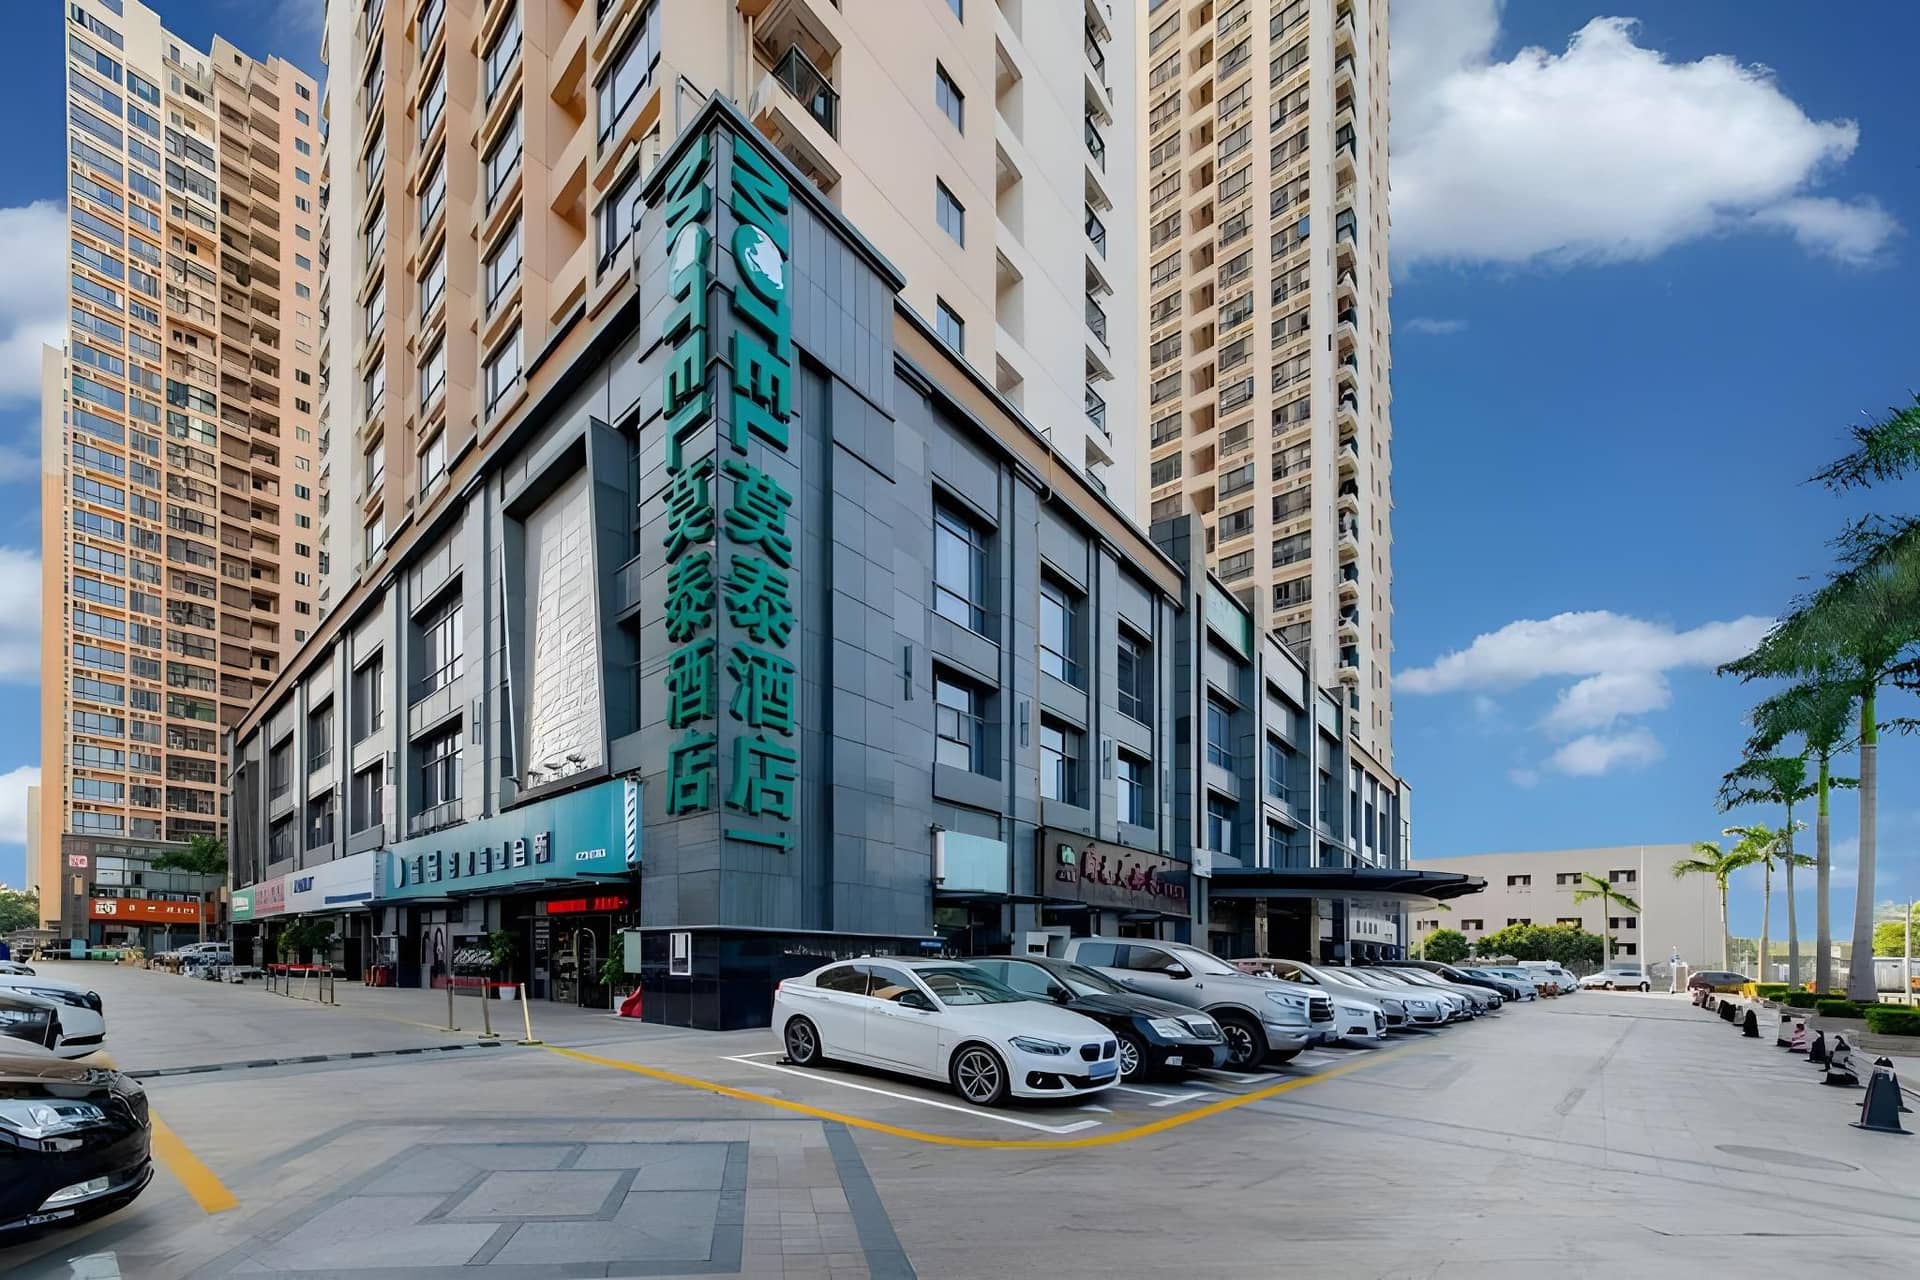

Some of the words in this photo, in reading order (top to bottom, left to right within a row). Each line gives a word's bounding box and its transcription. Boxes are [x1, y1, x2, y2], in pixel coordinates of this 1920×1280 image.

[731, 134, 791, 456] MOTEL
[663, 458, 717, 816] 莫泰酒店
[721, 458, 798, 822] 莫泰酒店
